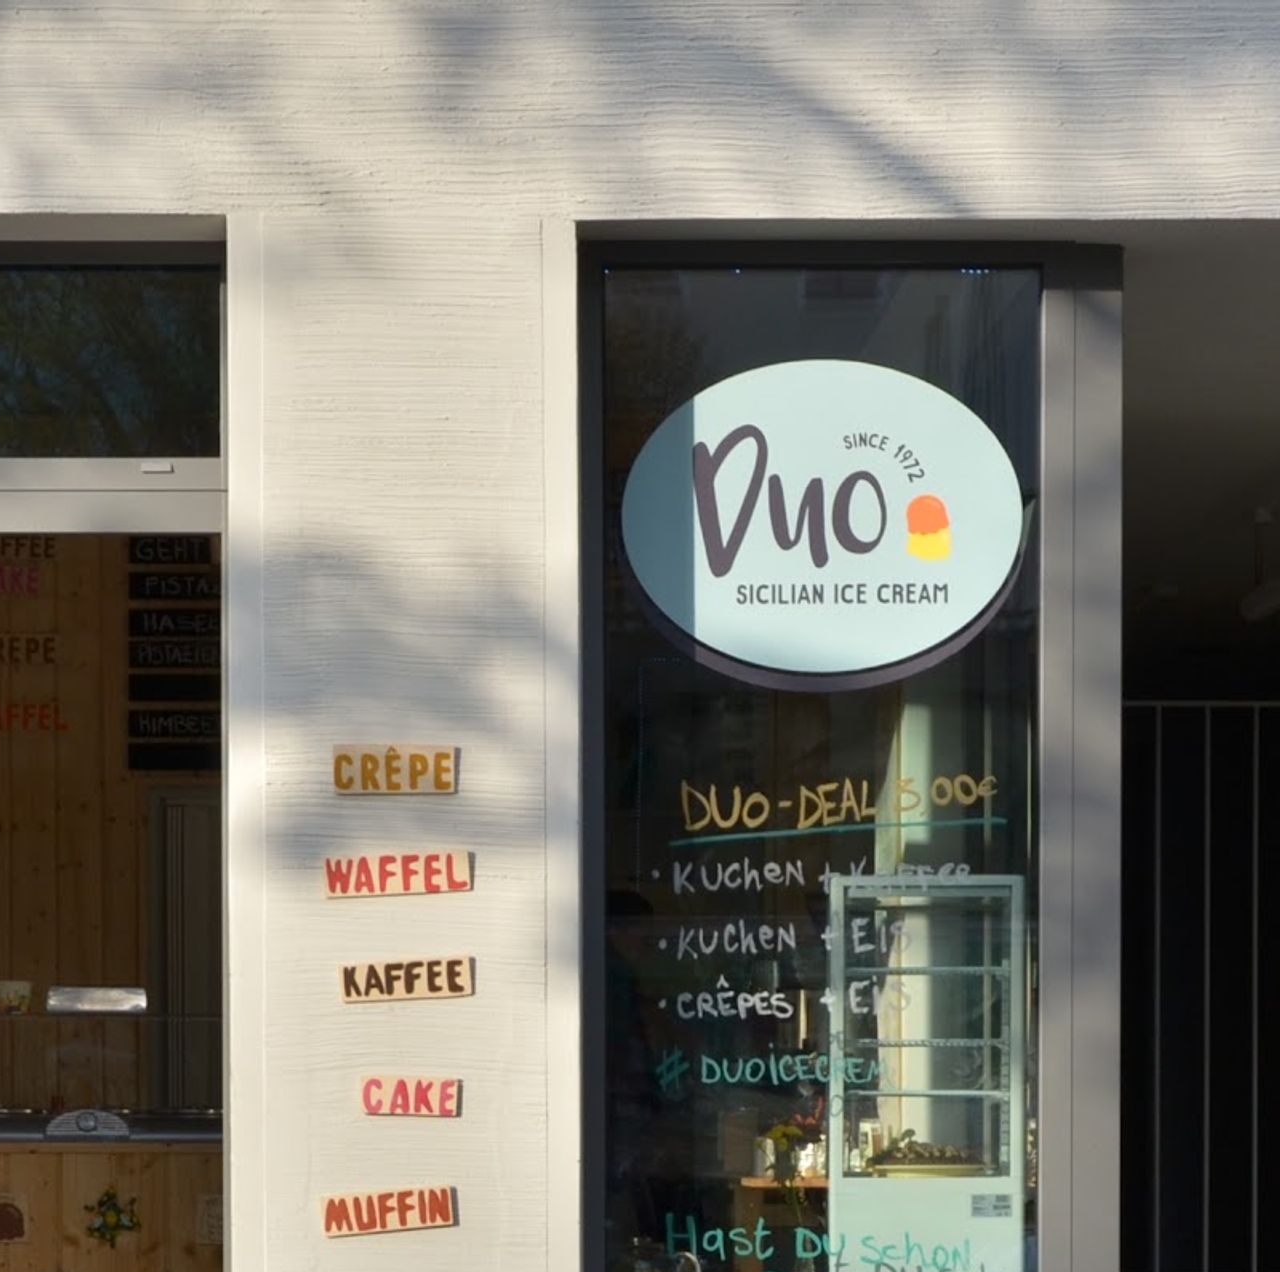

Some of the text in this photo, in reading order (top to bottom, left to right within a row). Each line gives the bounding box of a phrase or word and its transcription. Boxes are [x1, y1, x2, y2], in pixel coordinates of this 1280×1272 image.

[843, 432, 925, 482] SINCE 1972
[692, 424, 887, 578] Duo
[736, 583, 949, 605] SICILIAN ICE CREAM
[333, 745, 452, 791] CRÊPE
[325, 853, 469, 895] WAFFEL
[343, 960, 465, 998] KAFFEE
[362, 1078, 456, 1116] CAKE
[324, 1187, 451, 1233] MUFFIN
[666, 1212, 775, 1260] Hast
